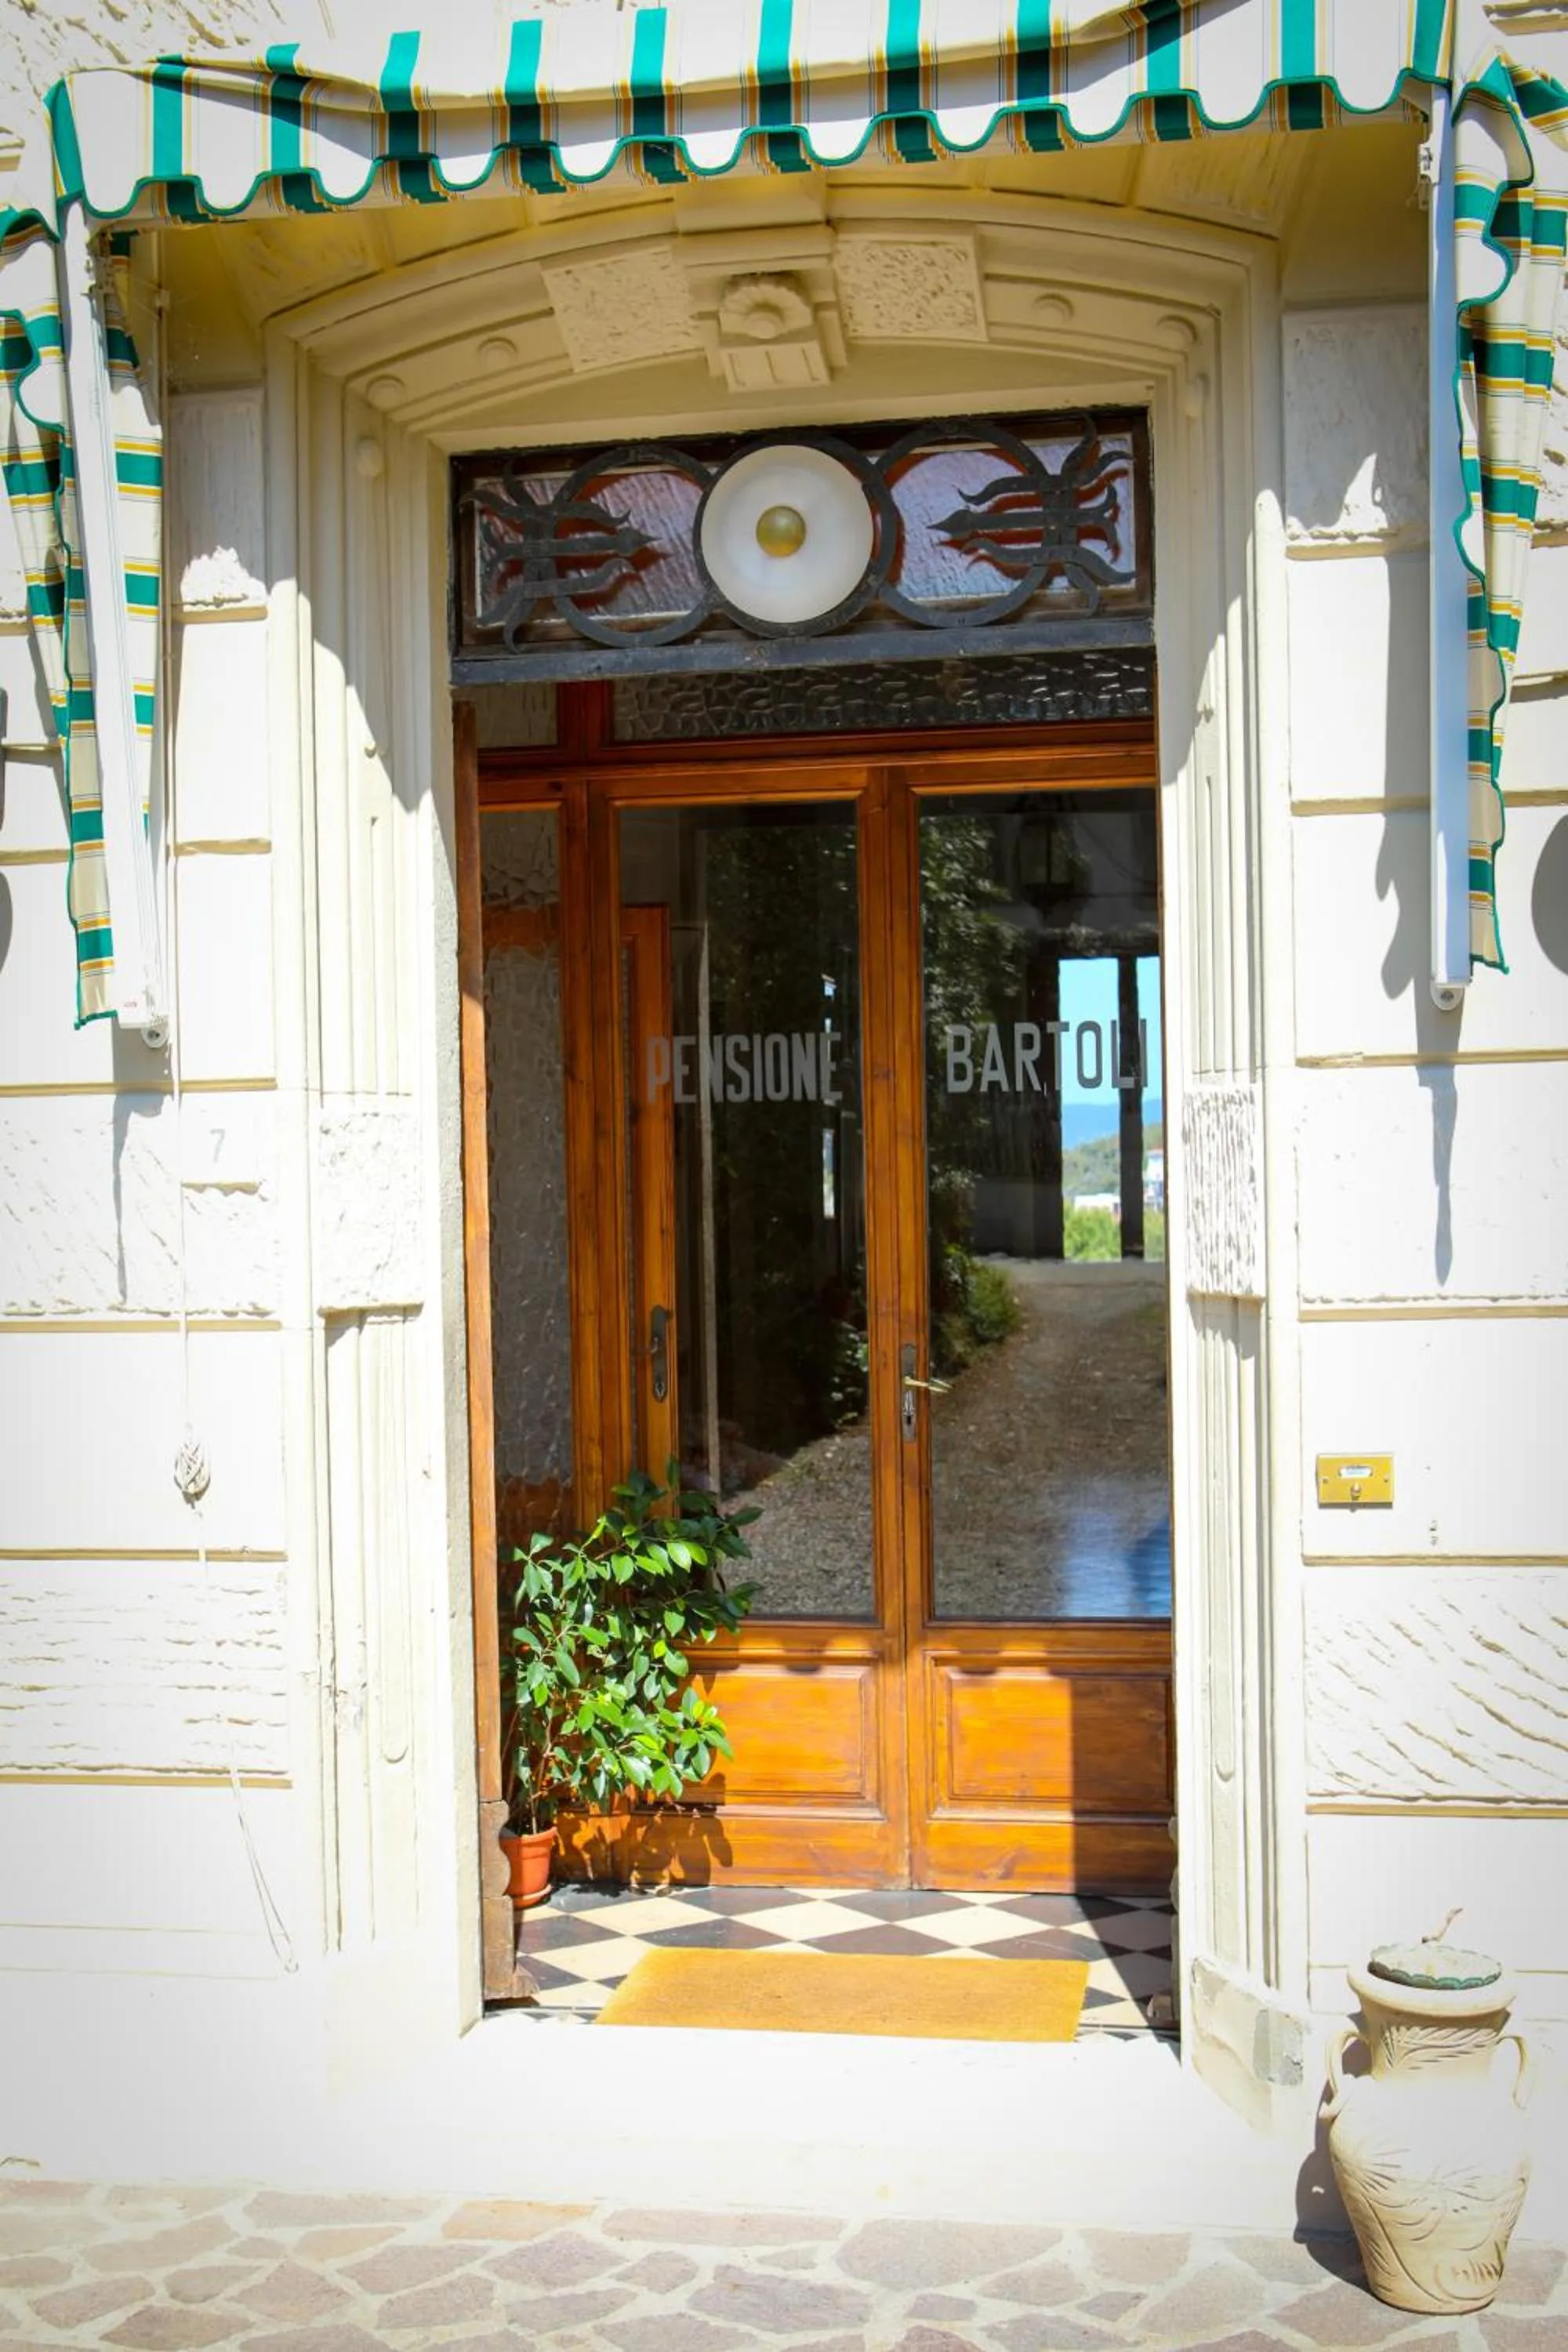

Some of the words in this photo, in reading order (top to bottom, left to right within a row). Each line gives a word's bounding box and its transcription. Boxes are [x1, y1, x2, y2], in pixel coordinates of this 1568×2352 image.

[647, 1032, 843, 1103] PENSIONE
[946, 1018, 1148, 1094] BARTOLI
[209, 1128, 226, 1163] 7
